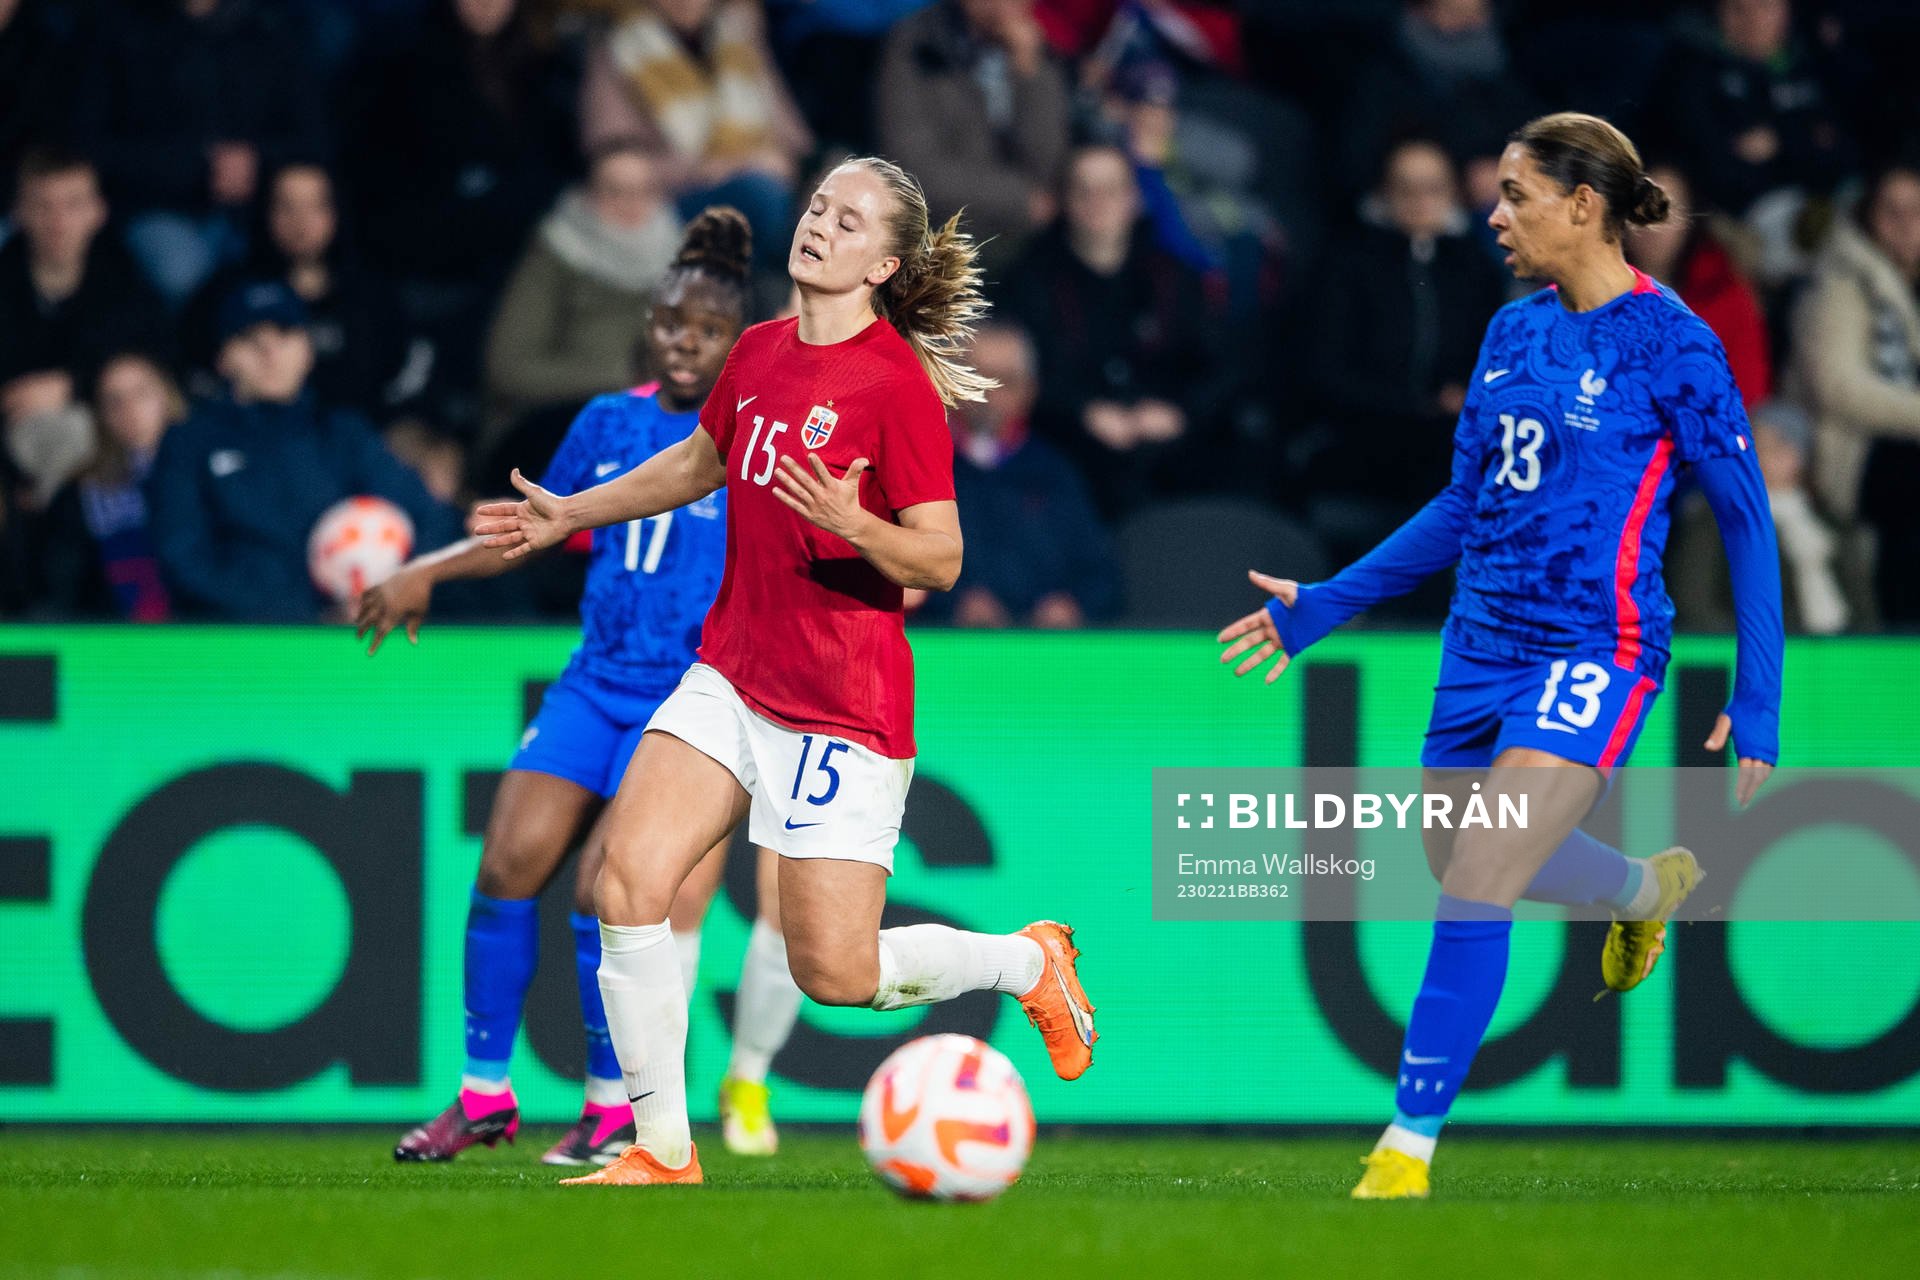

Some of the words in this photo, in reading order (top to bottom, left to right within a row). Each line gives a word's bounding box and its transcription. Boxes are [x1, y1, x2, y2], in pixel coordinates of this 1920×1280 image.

[741, 415, 789, 486] 15
[1495, 413, 1545, 492] 13
[624, 510, 674, 575] 17
[1536, 660, 1611, 728] 13
[791, 735, 849, 806] 15
